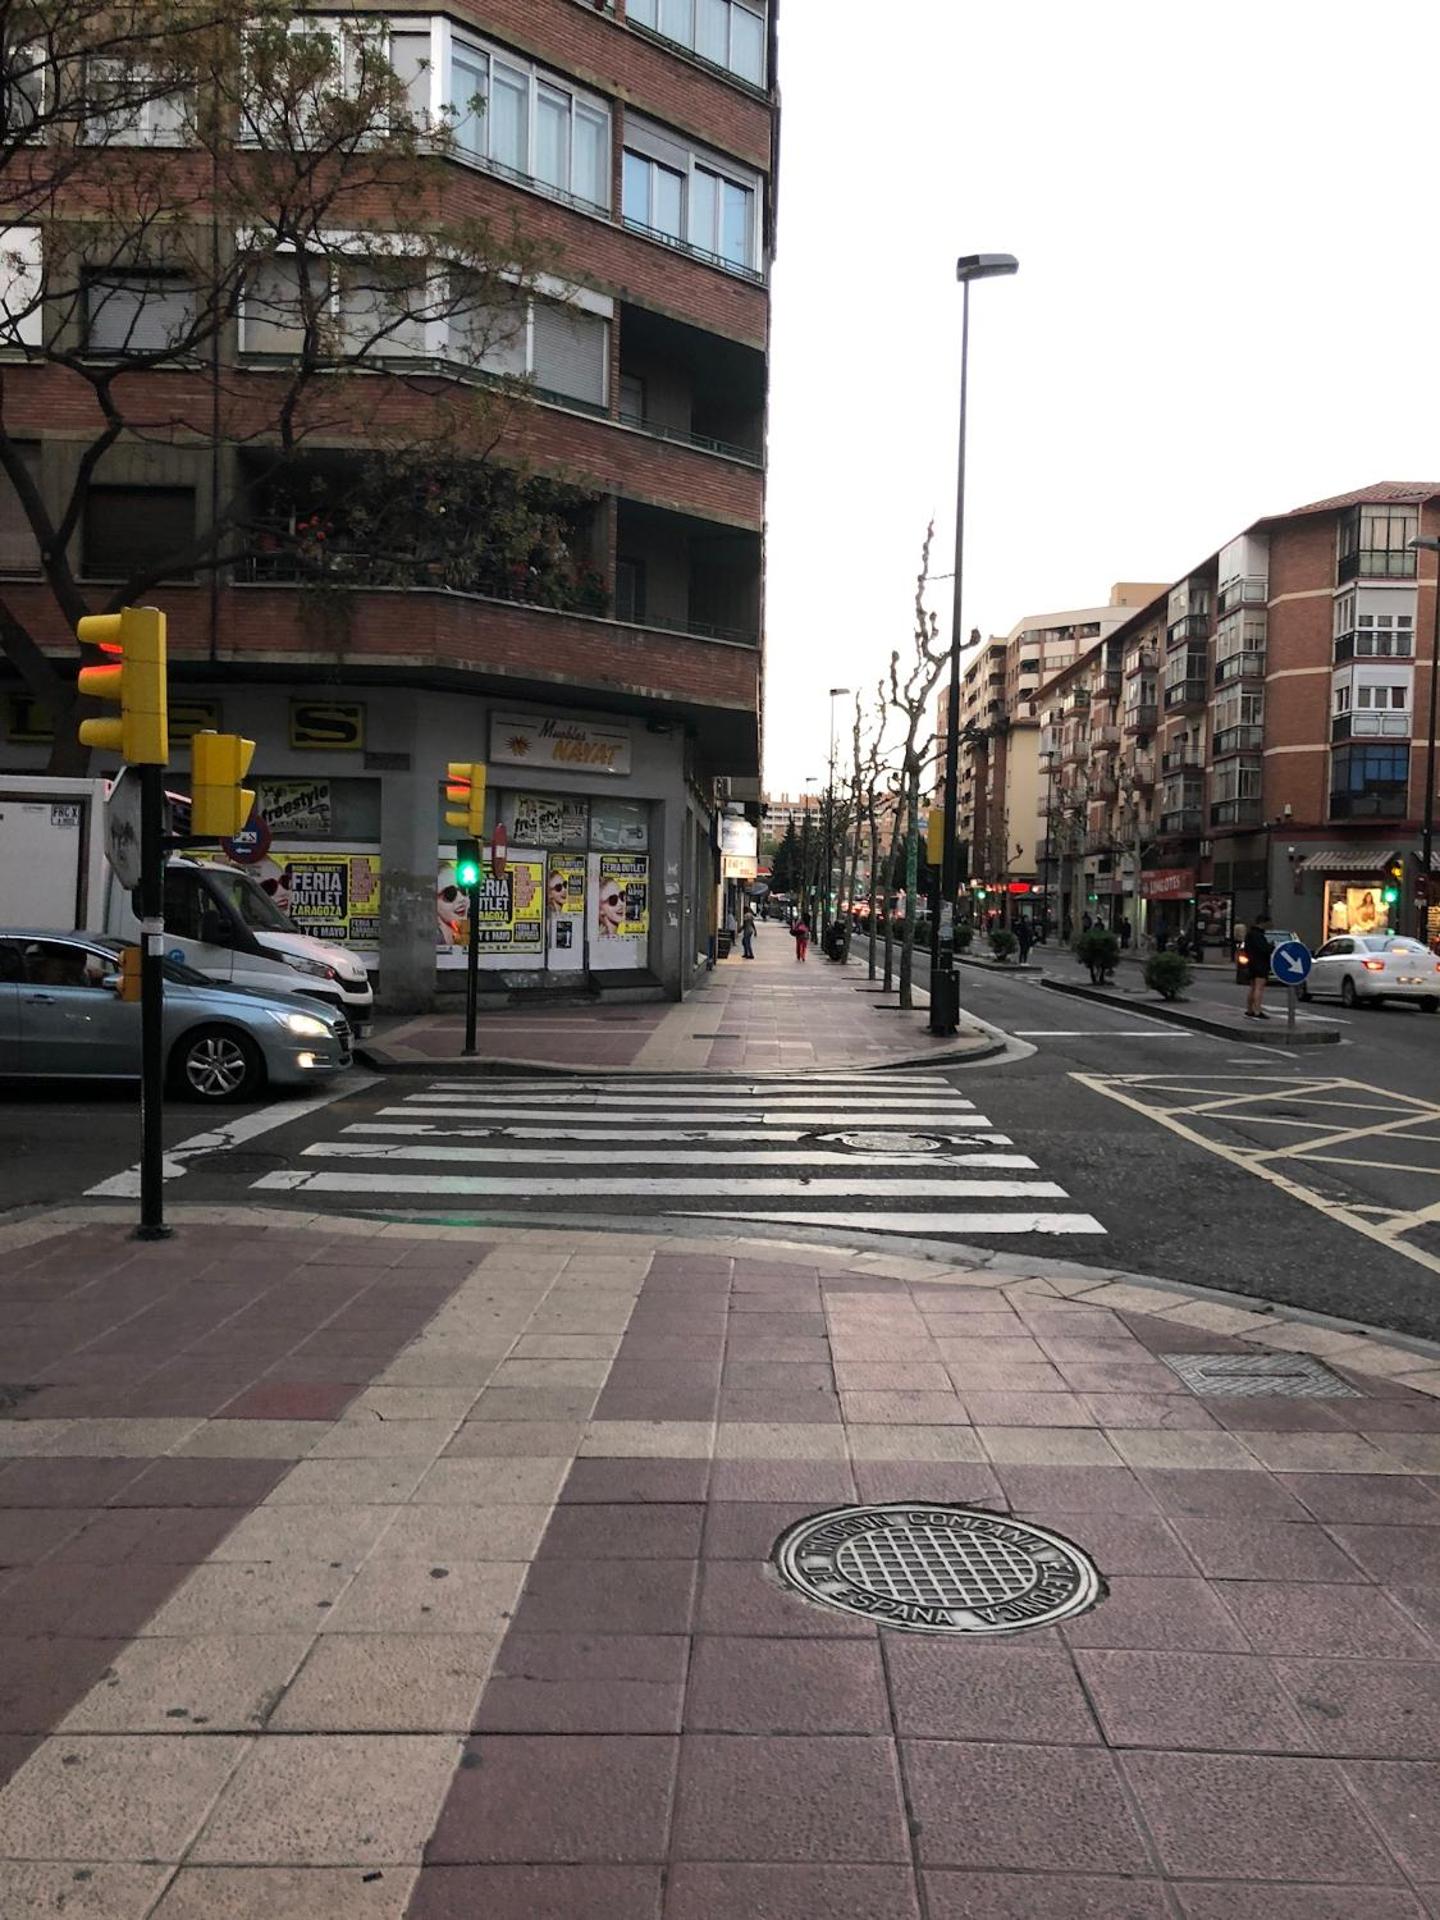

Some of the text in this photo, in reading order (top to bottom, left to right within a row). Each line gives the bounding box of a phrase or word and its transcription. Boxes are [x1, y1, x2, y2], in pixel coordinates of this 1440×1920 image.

[538, 718, 587, 741] Muebles
[262, 785, 328, 822] freestyle
[292, 872, 342, 891] FERIA
[479, 878, 509, 897] ERIA
[292, 890, 342, 905] OUTLET
[291, 904, 342, 916] ZARAGOZA
[313, 927, 320, 937] 6
[320, 927, 346, 938] MAYO
[800, 1513, 895, 1559] NACIONAL
[801, 1565, 844, 1586] DE
[972, 1554, 1075, 1625] TELEFONICA
